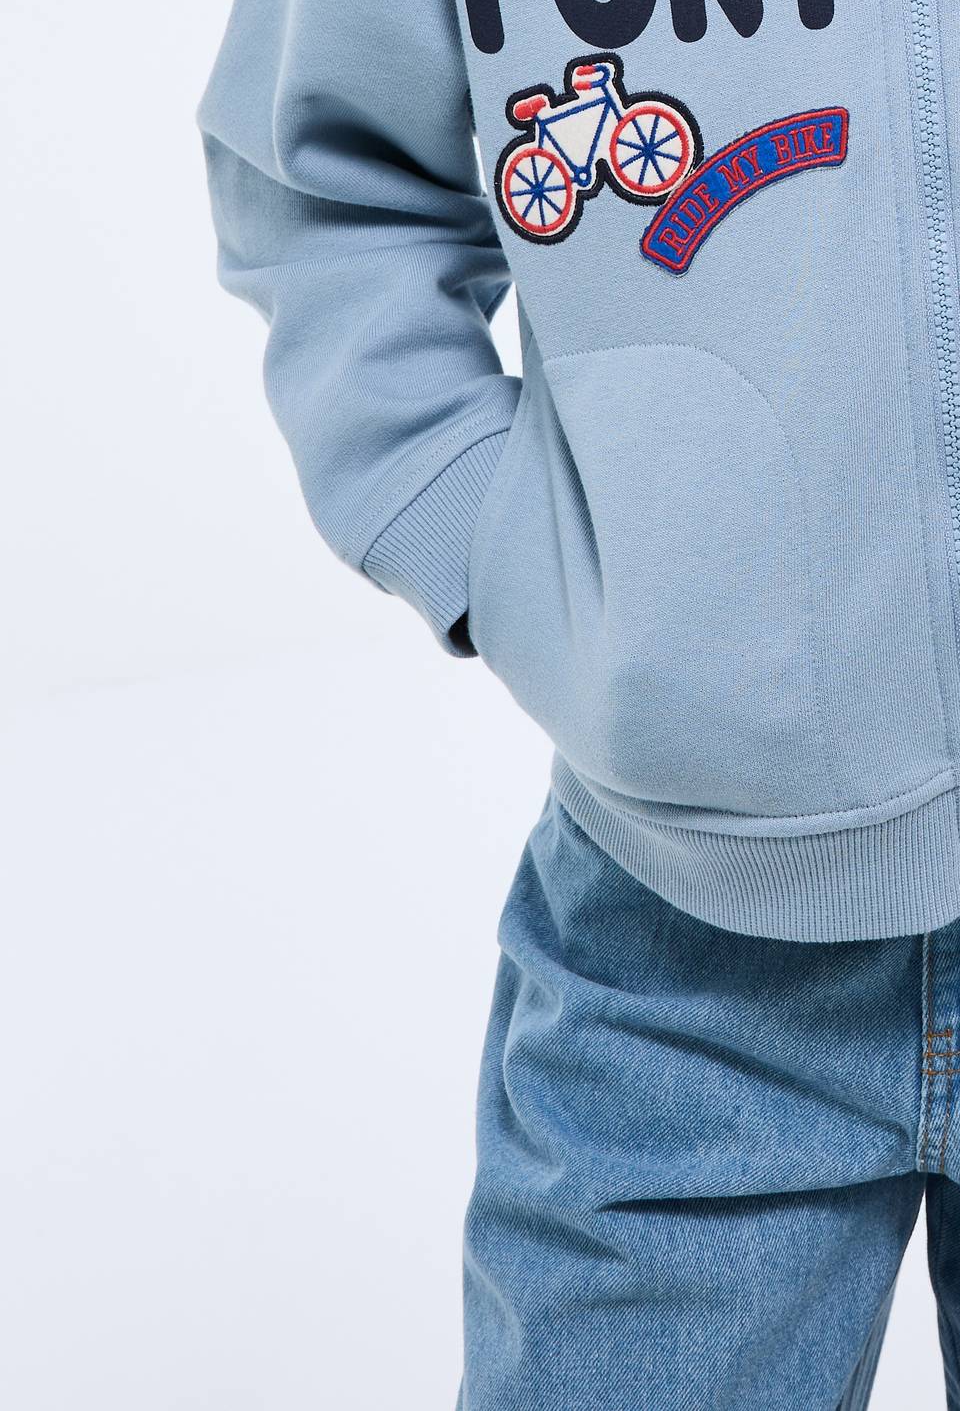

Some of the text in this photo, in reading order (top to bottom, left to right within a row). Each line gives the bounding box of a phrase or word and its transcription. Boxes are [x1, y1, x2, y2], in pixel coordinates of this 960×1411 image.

[660, 122, 834, 257] RIDE MY BIKE
